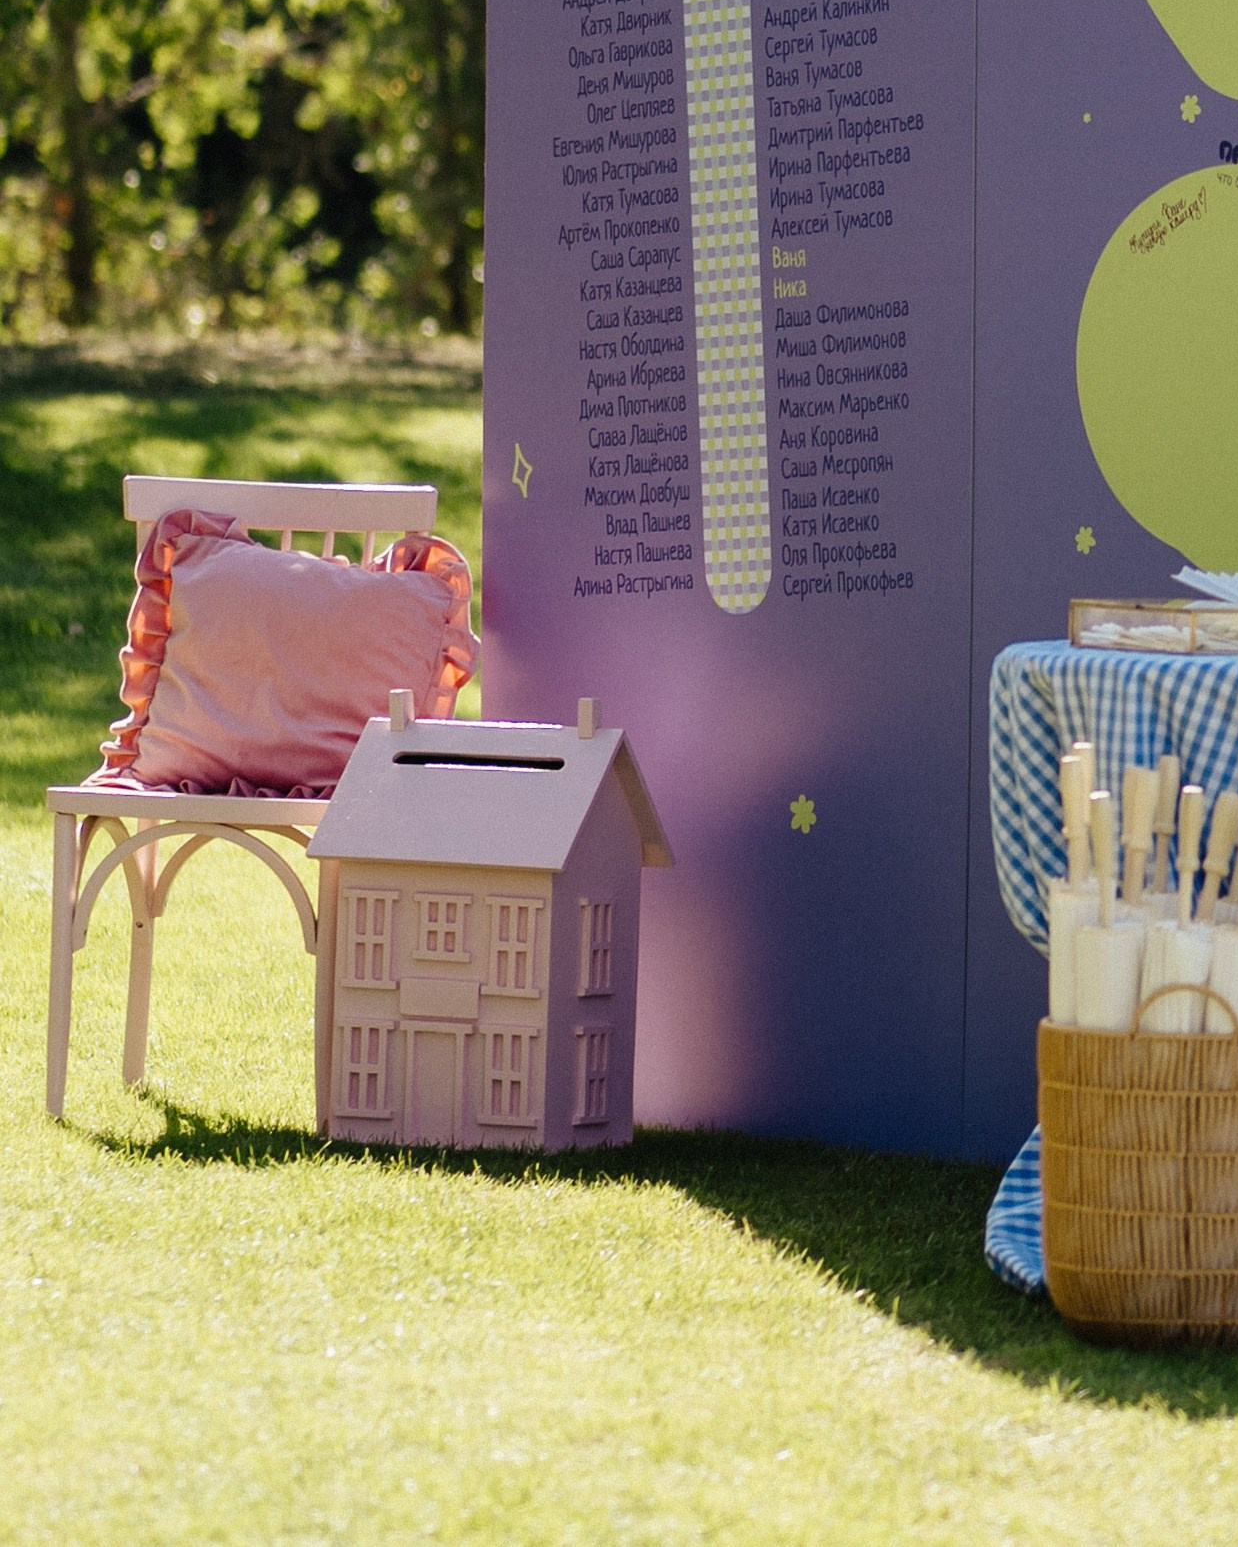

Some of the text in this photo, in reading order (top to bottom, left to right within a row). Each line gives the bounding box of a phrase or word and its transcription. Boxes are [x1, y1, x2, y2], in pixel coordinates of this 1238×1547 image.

[581, 9, 672, 36] Катя Двирник
[764, 2, 817, 31] Андрей
[569, 39, 673, 68] Ольга Гаврикова
[765, 27, 877, 63] Сергей Тумасов
[613, 69, 674, 94] Мишуров
[765, 60, 862, 89] Ваня Тумасов
[588, 103, 617, 124] Олег
[767, 87, 893, 117] Татьяна Тумасова
[553, 128, 676, 157] Евгения Мишурова
[768, 114, 924, 150] Дмитрий Парфентьев
[563, 158, 677, 186] Юлия Растрыгина
[769, 146, 910, 184] Ирина Парфентьева
[1217, 173, 1232, 186] что
[583, 187, 679, 214] Катя Тумасова
[770, 180, 884, 214] Ирина Тумасова
[559, 217, 679, 250] Артём Прокопенко
[771, 210, 893, 239] Алексей Тумасов
[591, 246, 681, 272] Саша Сарапус
[772, 246, 806, 268] Ваня
[581, 276, 682, 301] Катя Казанцева
[773, 278, 806, 299] Ника
[587, 305, 683, 331] Саша Казанцев
[775, 300, 909, 331] Даша Филимонова
[580, 332, 684, 360] Настя Оболдина
[776, 331, 906, 358] Миша Филимонов
[587, 360, 685, 395] Арина Ибряева
[777, 362, 908, 389] Нина Овсянникова
[579, 395, 686, 422] Дима Плотников
[778, 393, 909, 420] Максим Марьенко
[589, 423, 687, 449] Слава Лащёнов
[779, 425, 878, 452] Аня Коровина
[589, 453, 688, 477] Катя Лащёнова
[781, 455, 893, 480] Саша Месропян
[584, 477, 690, 508] Максим Довбуш
[782, 486, 879, 510] Паша Исаенко
[606, 512, 690, 536] Влад Пашнев
[782, 513, 879, 537] Катя Исаенко
[595, 542, 692, 565] Настя Пашнева
[782, 541, 896, 570] Оля Прокофьева
[574, 573, 693, 599] Алина Растрыгина
[783, 570, 913, 602] Сергей Прокофьев
